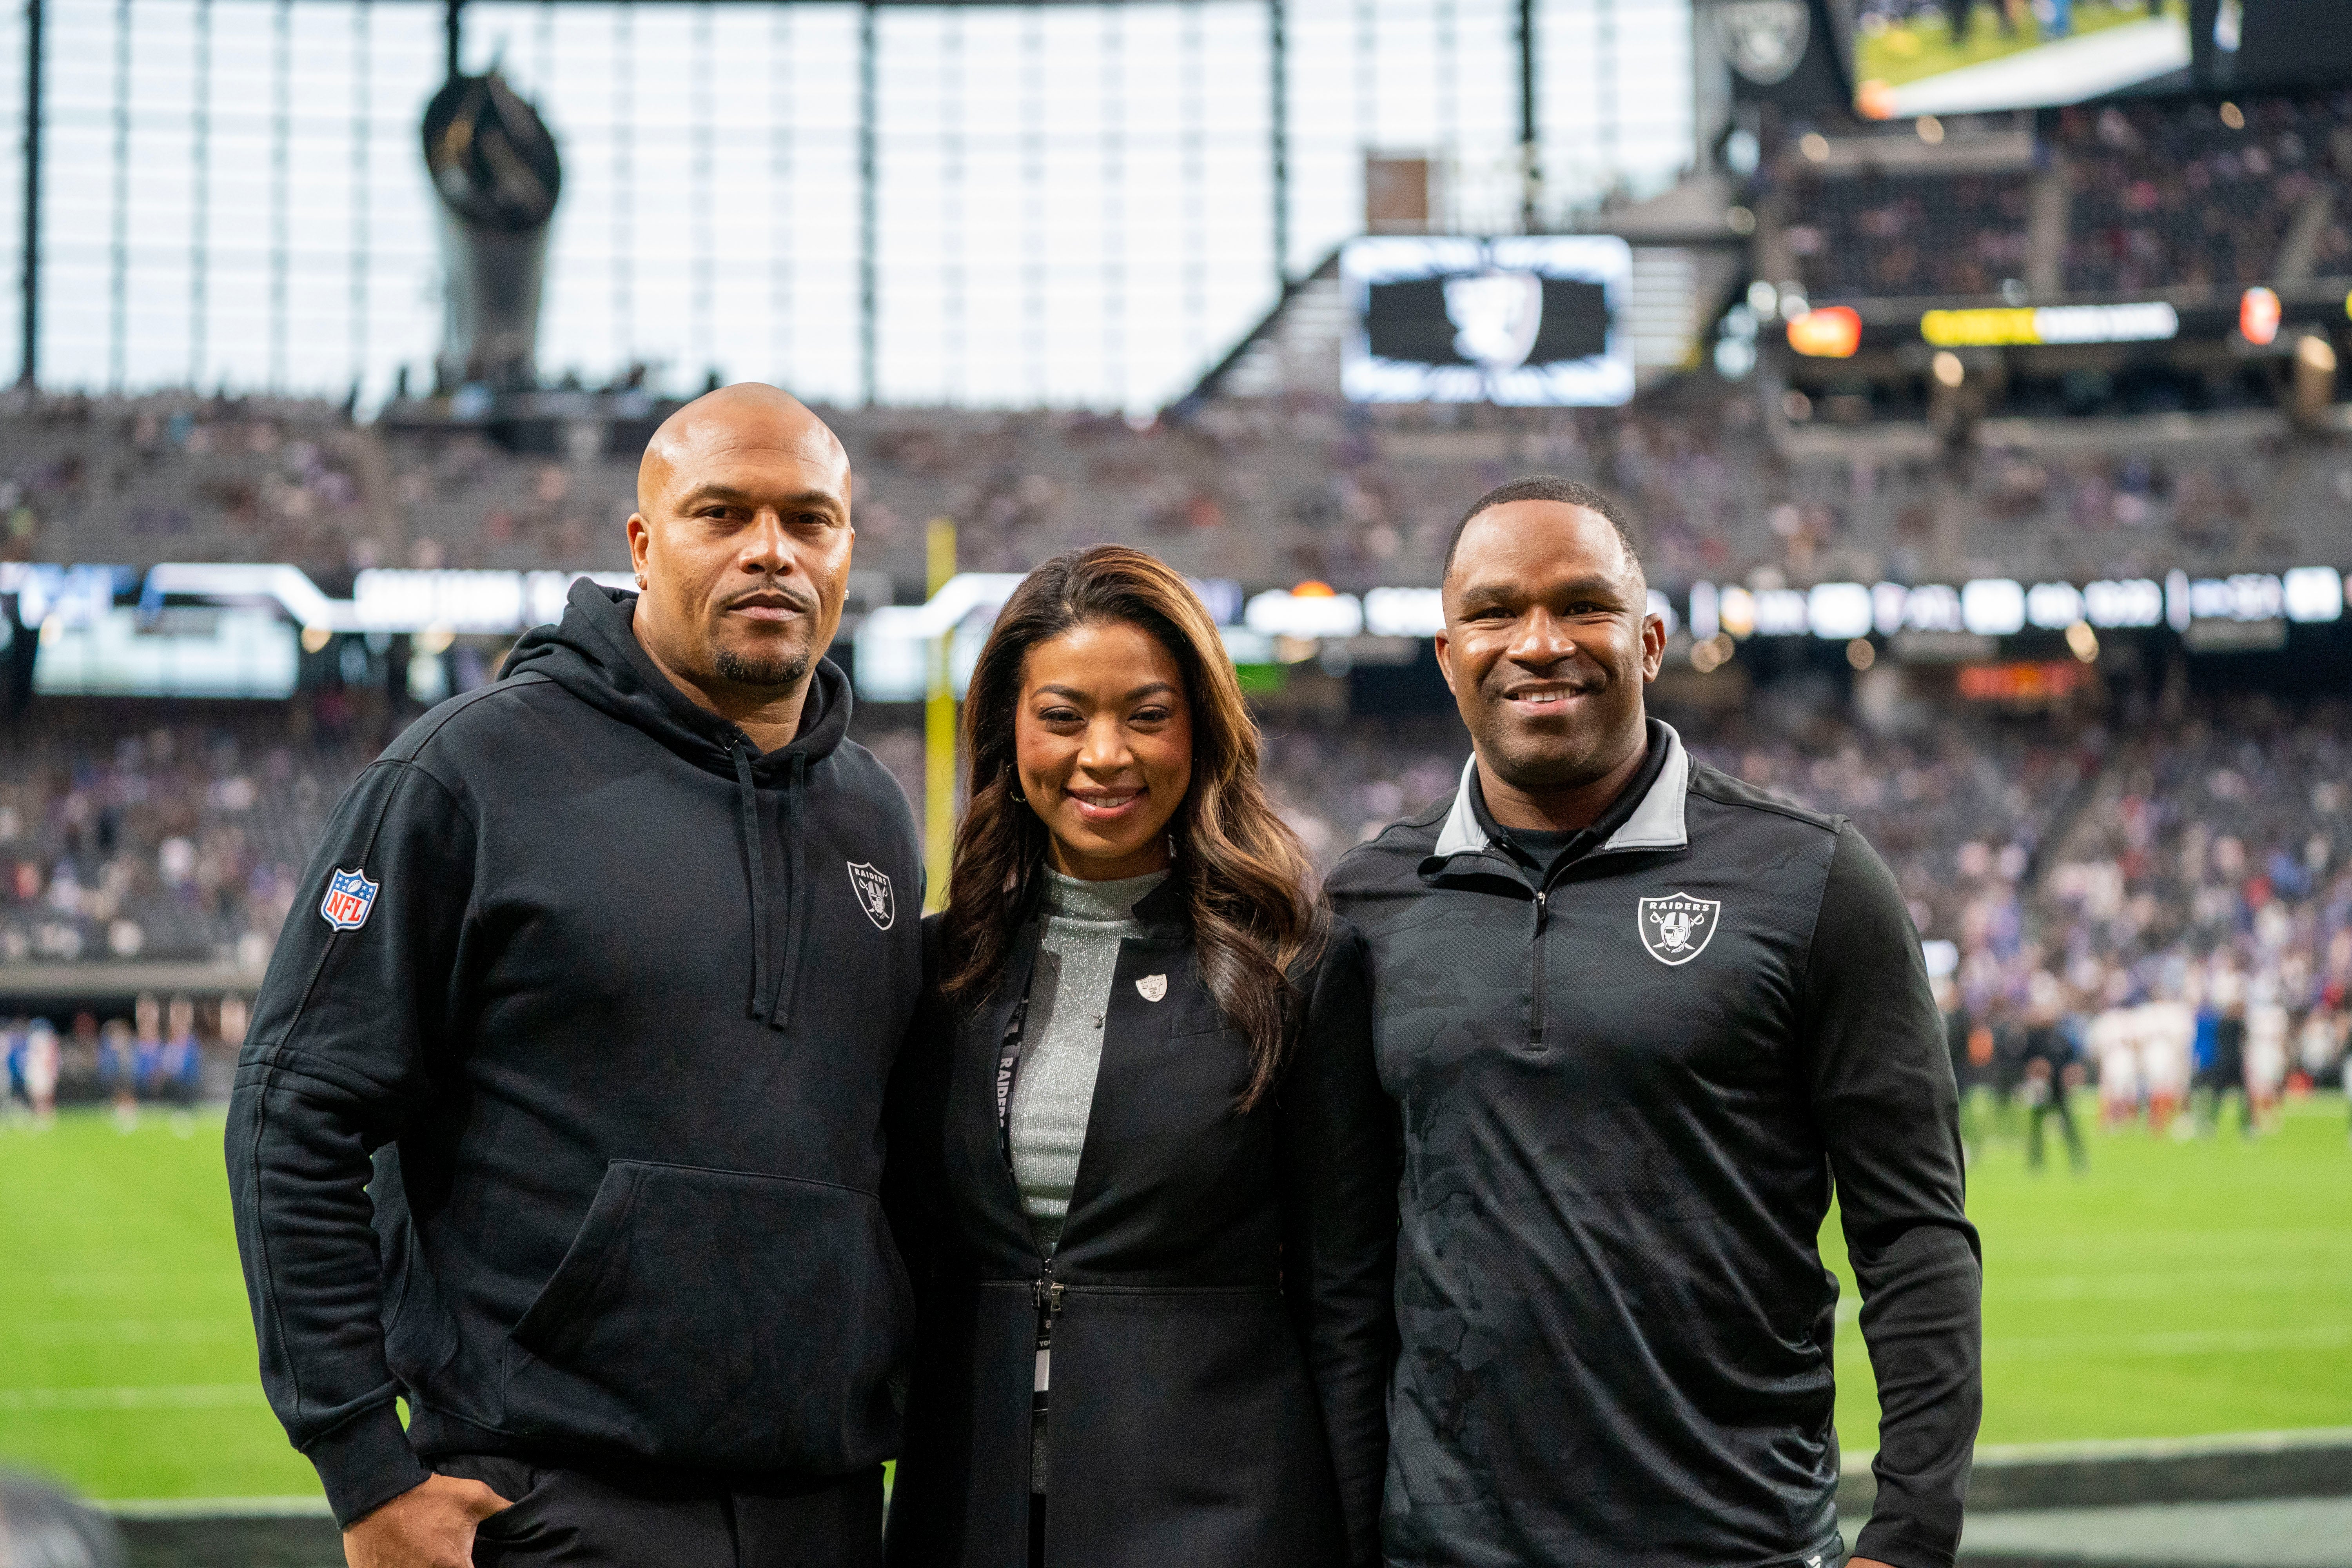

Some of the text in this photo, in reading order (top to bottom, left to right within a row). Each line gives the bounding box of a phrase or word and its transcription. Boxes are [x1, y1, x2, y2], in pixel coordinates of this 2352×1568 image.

[854, 867, 887, 886] RAIDERS
[327, 891, 362, 922] NFL
[1649, 902, 1710, 912] RAIDERS
[997, 1057, 1013, 1127] RAIDE
